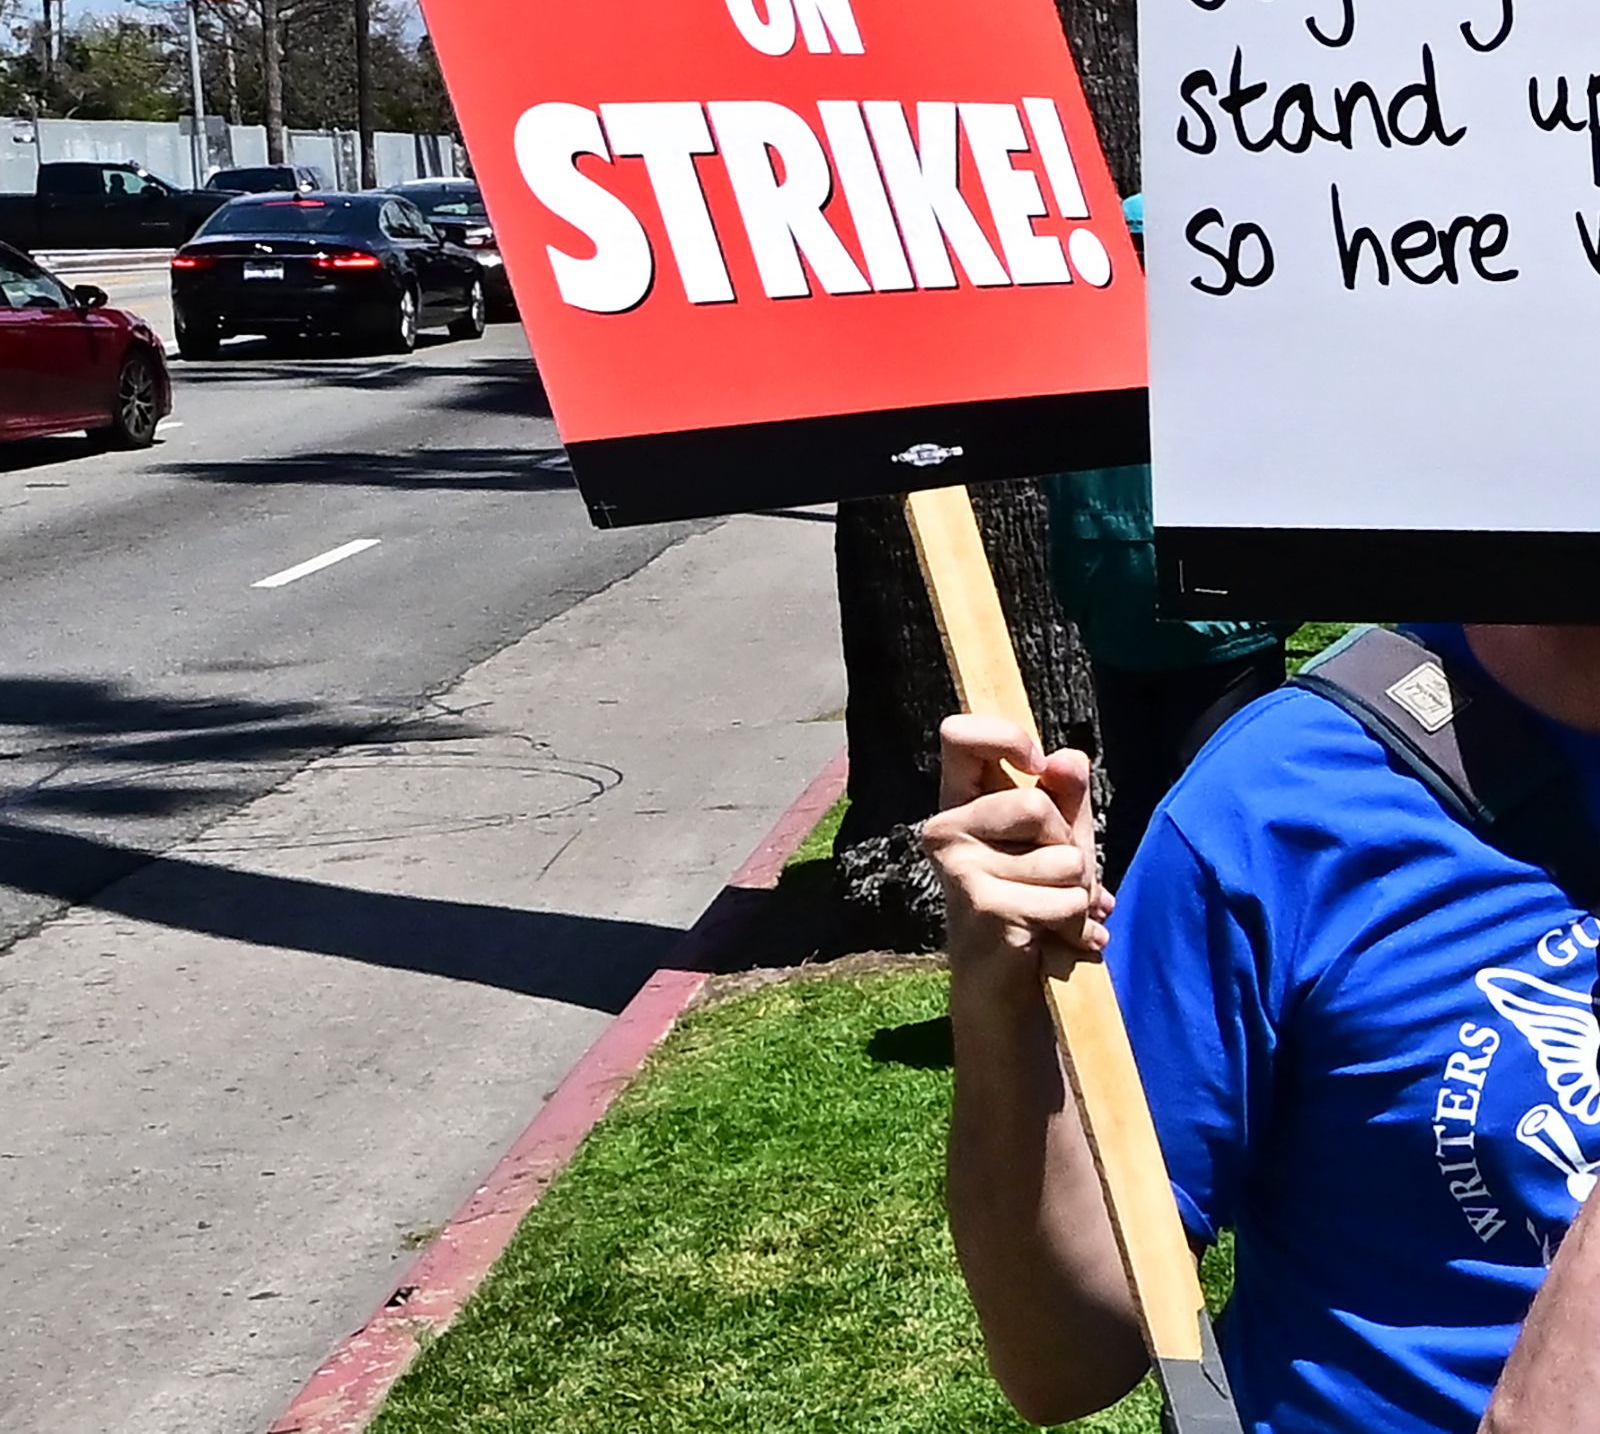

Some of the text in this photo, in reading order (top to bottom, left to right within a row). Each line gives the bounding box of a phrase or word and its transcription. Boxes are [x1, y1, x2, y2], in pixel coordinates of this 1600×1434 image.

[1177, 44, 1467, 155] stand
[513, 96, 1111, 313] STRIKE!
[1185, 207, 1275, 296] so
[1331, 183, 1519, 290] here
[1433, 1021, 1507, 1244] WRITERS
